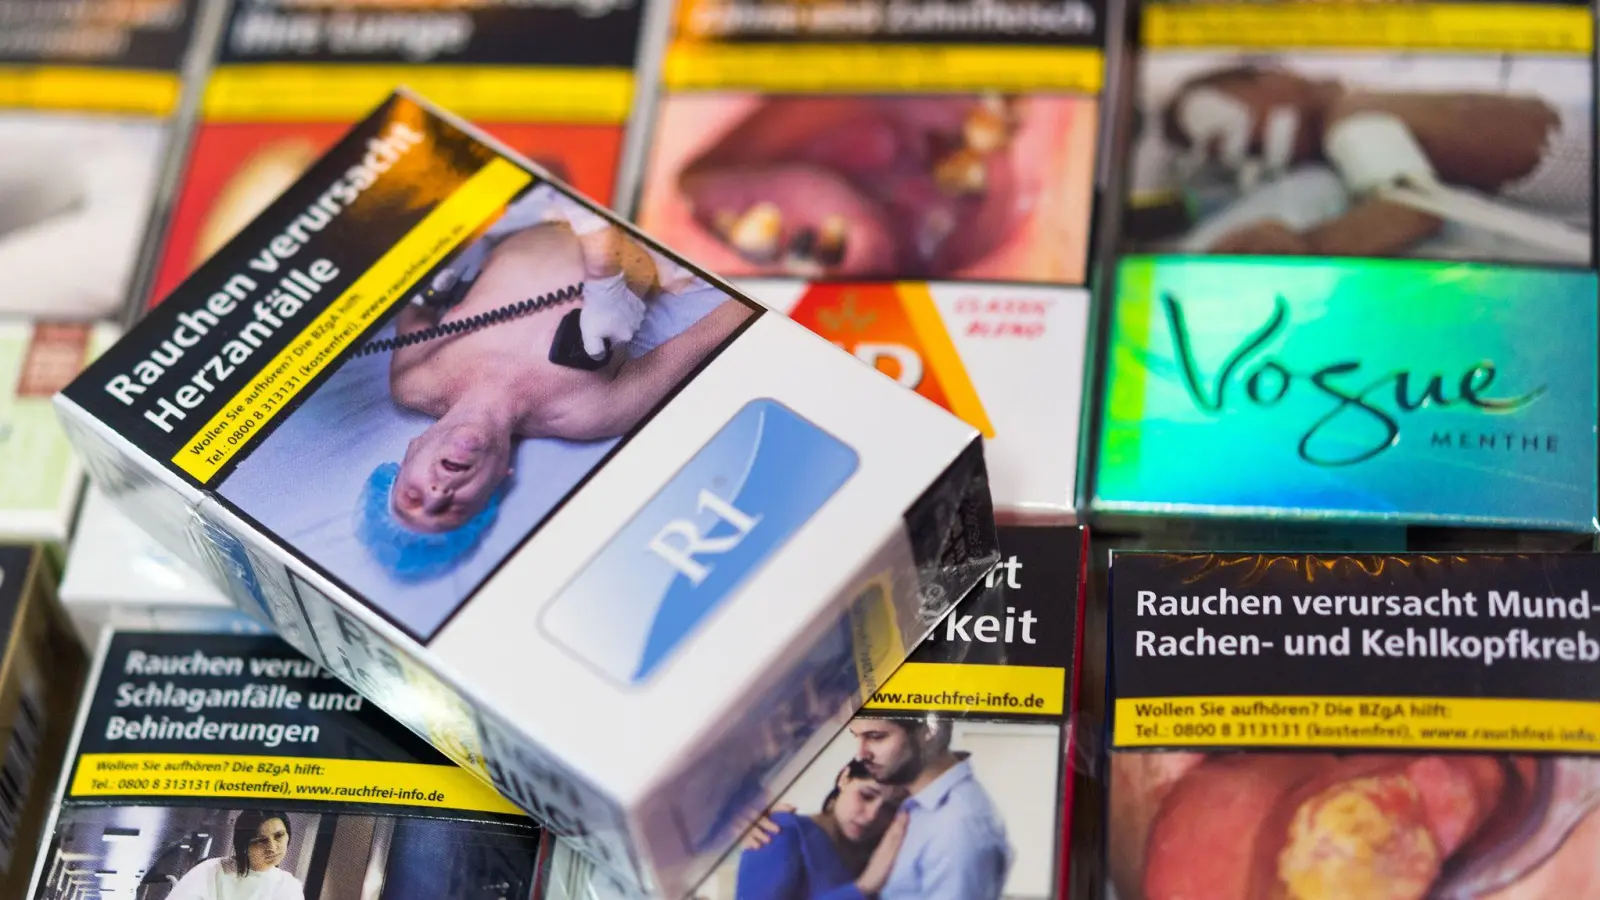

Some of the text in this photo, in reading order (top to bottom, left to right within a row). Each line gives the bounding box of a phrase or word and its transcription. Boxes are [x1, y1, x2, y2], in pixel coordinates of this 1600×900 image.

[104, 121, 425, 406] Rauchen verursacht
[144, 258, 340, 433] Herzanfälle
[1161, 292, 1548, 467] Vogue
[190, 420, 229, 456] Wollen
[226, 404, 246, 422] Sie
[245, 355, 294, 405] aufhören?
[292, 339, 313, 358] Die
[205, 445, 231, 467] Tel.:
[227, 419, 255, 446] 0800
[253, 410, 264, 421] 8
[261, 375, 301, 413] 313131
[1430, 431, 1560, 454] MENTHE
[648, 487, 764, 590] R1
[1136, 588, 1600, 619] Rauchen verursacht Mund-
[927, 607, 1038, 645] keit
[124, 650, 243, 676] Rauchen
[1135, 627, 1600, 667] Rachen- und Kehlkopfkreb
[114, 682, 302, 713] Schlaganfälle
[872, 690, 1045, 708] ww.rauchfrei-info.de
[1135, 703, 1194, 717] Wollen
[1200, 703, 1225, 717] Sie
[1230, 703, 1320, 717] aufhören?
[1325, 703, 1353, 717] Die
[1359, 704, 1404, 720] BZgA
[105, 714, 320, 747] Behinderungen
[1173, 723, 1216, 738] 0800
[1221, 723, 1232, 737] 8
[1237, 723, 1300, 737] 313131
[96, 760, 325, 777] Wollen Sie aufhören? Die BZgA hilft:
[118, 778, 149, 790] 0800
[152, 779, 161, 790] 8
[164, 779, 210, 791] 313131
[214, 779, 291, 796] (kostenfrei),
[296, 784, 445, 802] www.rauchfrei-info.de
